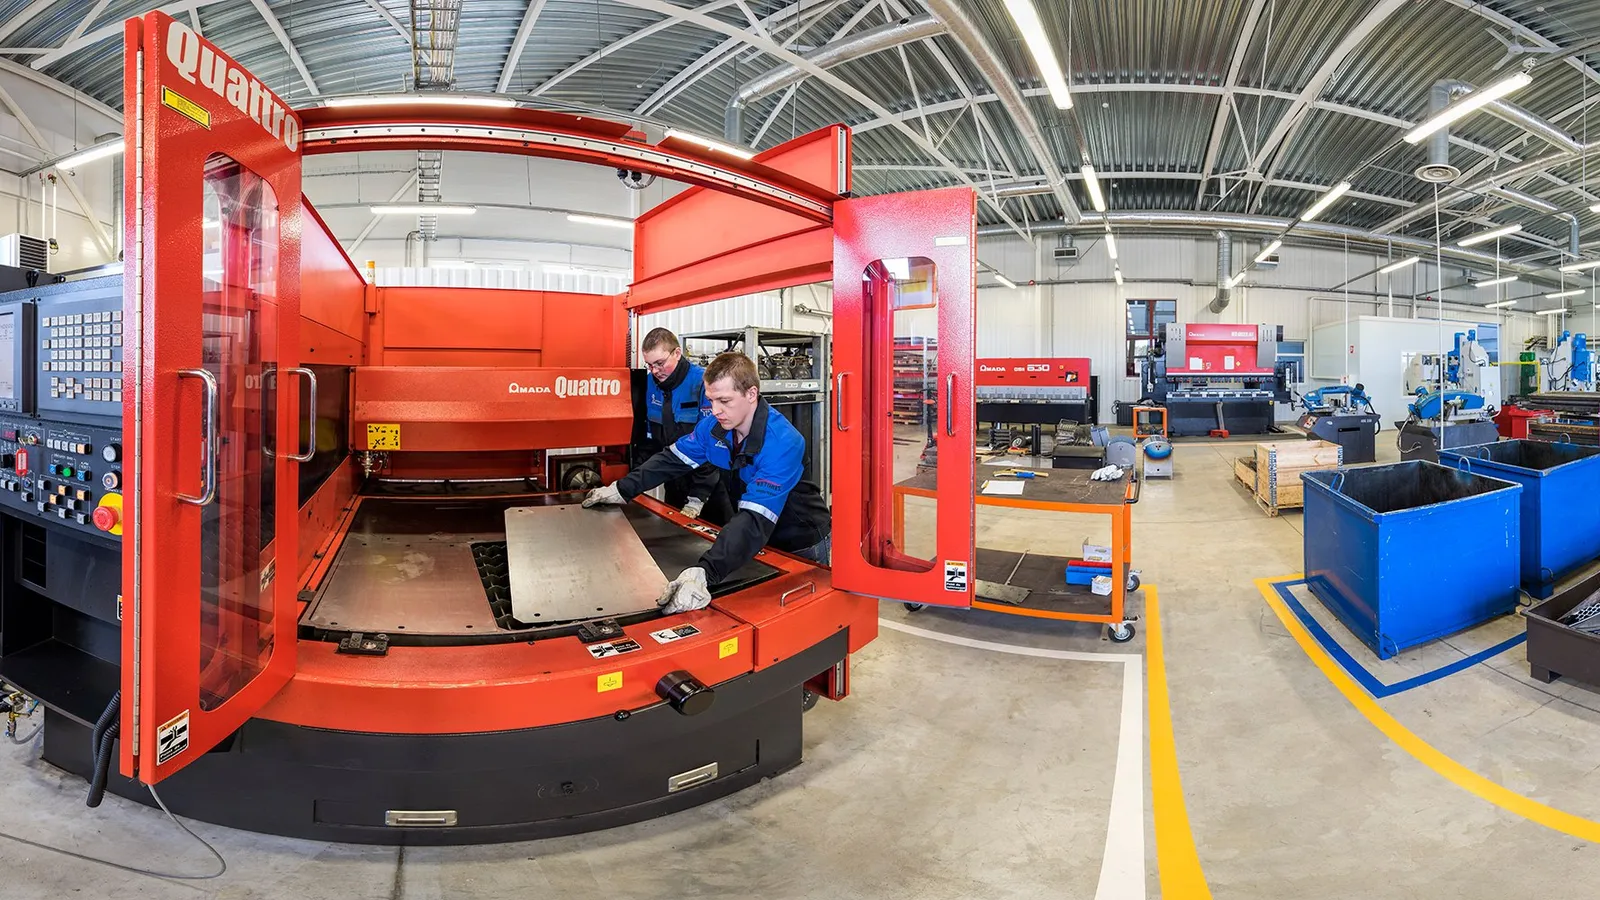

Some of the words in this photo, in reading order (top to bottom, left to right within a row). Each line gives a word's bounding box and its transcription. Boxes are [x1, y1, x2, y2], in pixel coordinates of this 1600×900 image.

[166, 21, 299, 153] Quattro
[979, 364, 1006, 372] AMADA
[554, 376, 621, 398] Quattro
